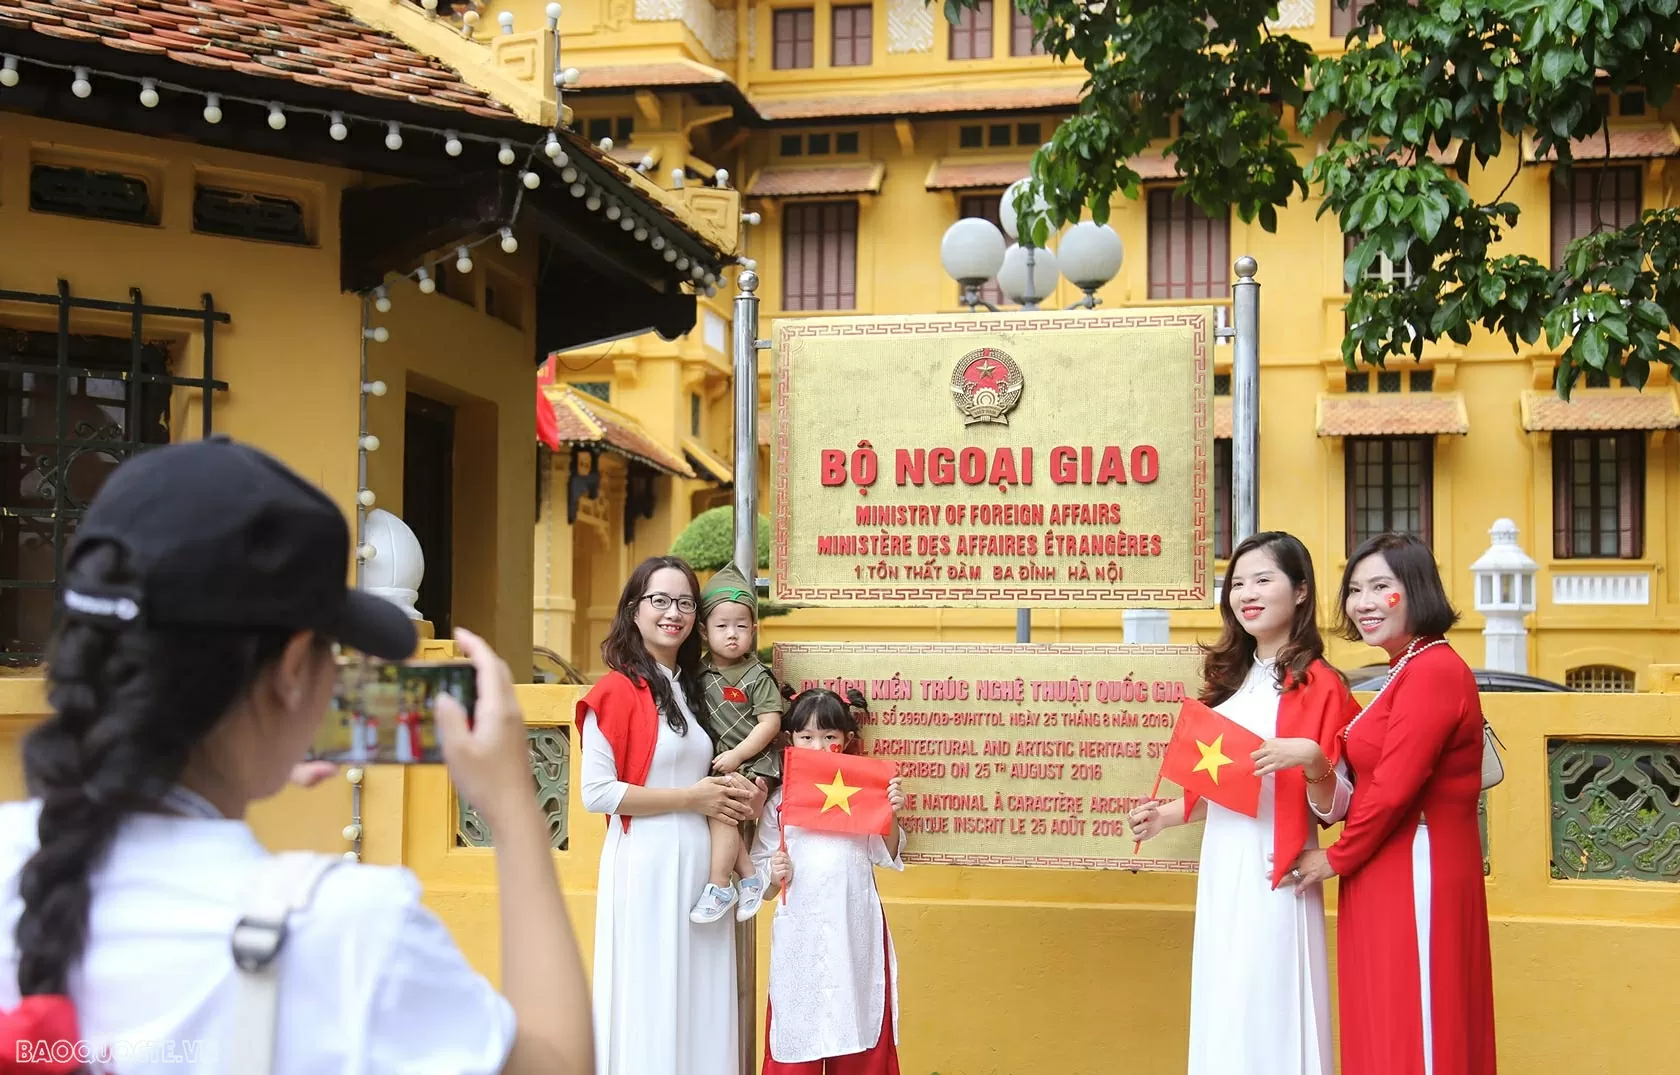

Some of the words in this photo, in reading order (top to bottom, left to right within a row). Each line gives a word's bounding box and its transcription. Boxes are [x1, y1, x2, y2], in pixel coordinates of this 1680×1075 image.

[821, 439, 877, 496] BỘ
[896, 447, 1033, 493] NGOẠI
[1050, 445, 1159, 485] GIAO
[856, 505, 940, 526] MINISTRY
[945, 505, 966, 525] OF
[970, 504, 1044, 526] FOREIGN
[1049, 503, 1121, 525] AFFAIRS
[817, 529, 912, 556] MINISTÈRE
[917, 535, 950, 556] DES
[956, 535, 1038, 556] AFFAIRES
[1044, 529, 1162, 557] ÉTRANGÈRES
[854, 565, 861, 580] 1
[867, 560, 898, 580] TÔN
[904, 558, 942, 580] THẤT
[947, 562, 981, 580] ĐÀM
[992, 565, 1014, 580] BA
[1019, 560, 1055, 580] ĐÌNH
[1068, 560, 1090, 580] HÀ
[1095, 560, 1123, 585] NỘI
[871, 671, 912, 700] KIẾN
[920, 676, 969, 700] TRÚC
[976, 676, 1024, 706] NGHỆ
[1030, 674, 1091, 706] THUẬT
[1096, 671, 1148, 704] QUỐC
[1152, 681, 1185, 703] GIA
[883, 704, 897, 726] SỐ
[1009, 709, 1040, 726] NGÀY
[1043, 712, 1058, 726] 25
[1061, 709, 1101, 727] THÁNG
[1103, 713, 1110, 727] 8
[1111, 709, 1138, 728] NĂM
[1142, 713, 1174, 728] 2016)
[873, 739, 978, 756] ARCHITECTURAL
[983, 740, 1011, 756] AND
[1015, 740, 1074, 757] ARTISTIC
[1079, 742, 1141, 758] HERITAGE
[1147, 742, 1168, 759] SIT
[950, 762, 969, 778] ON
[975, 762, 990, 779] 25
[1010, 762, 1064, 780] AUGUST
[1071, 763, 1102, 781] 2016
[922, 793, 988, 811] NATIONAL
[1007, 791, 1083, 813] CARACTÈRE
[953, 815, 1005, 834] INSCRIT
[1009, 817, 1026, 835] LE
[1030, 818, 1047, 836] 25
[1092, 819, 1123, 837] 2016
